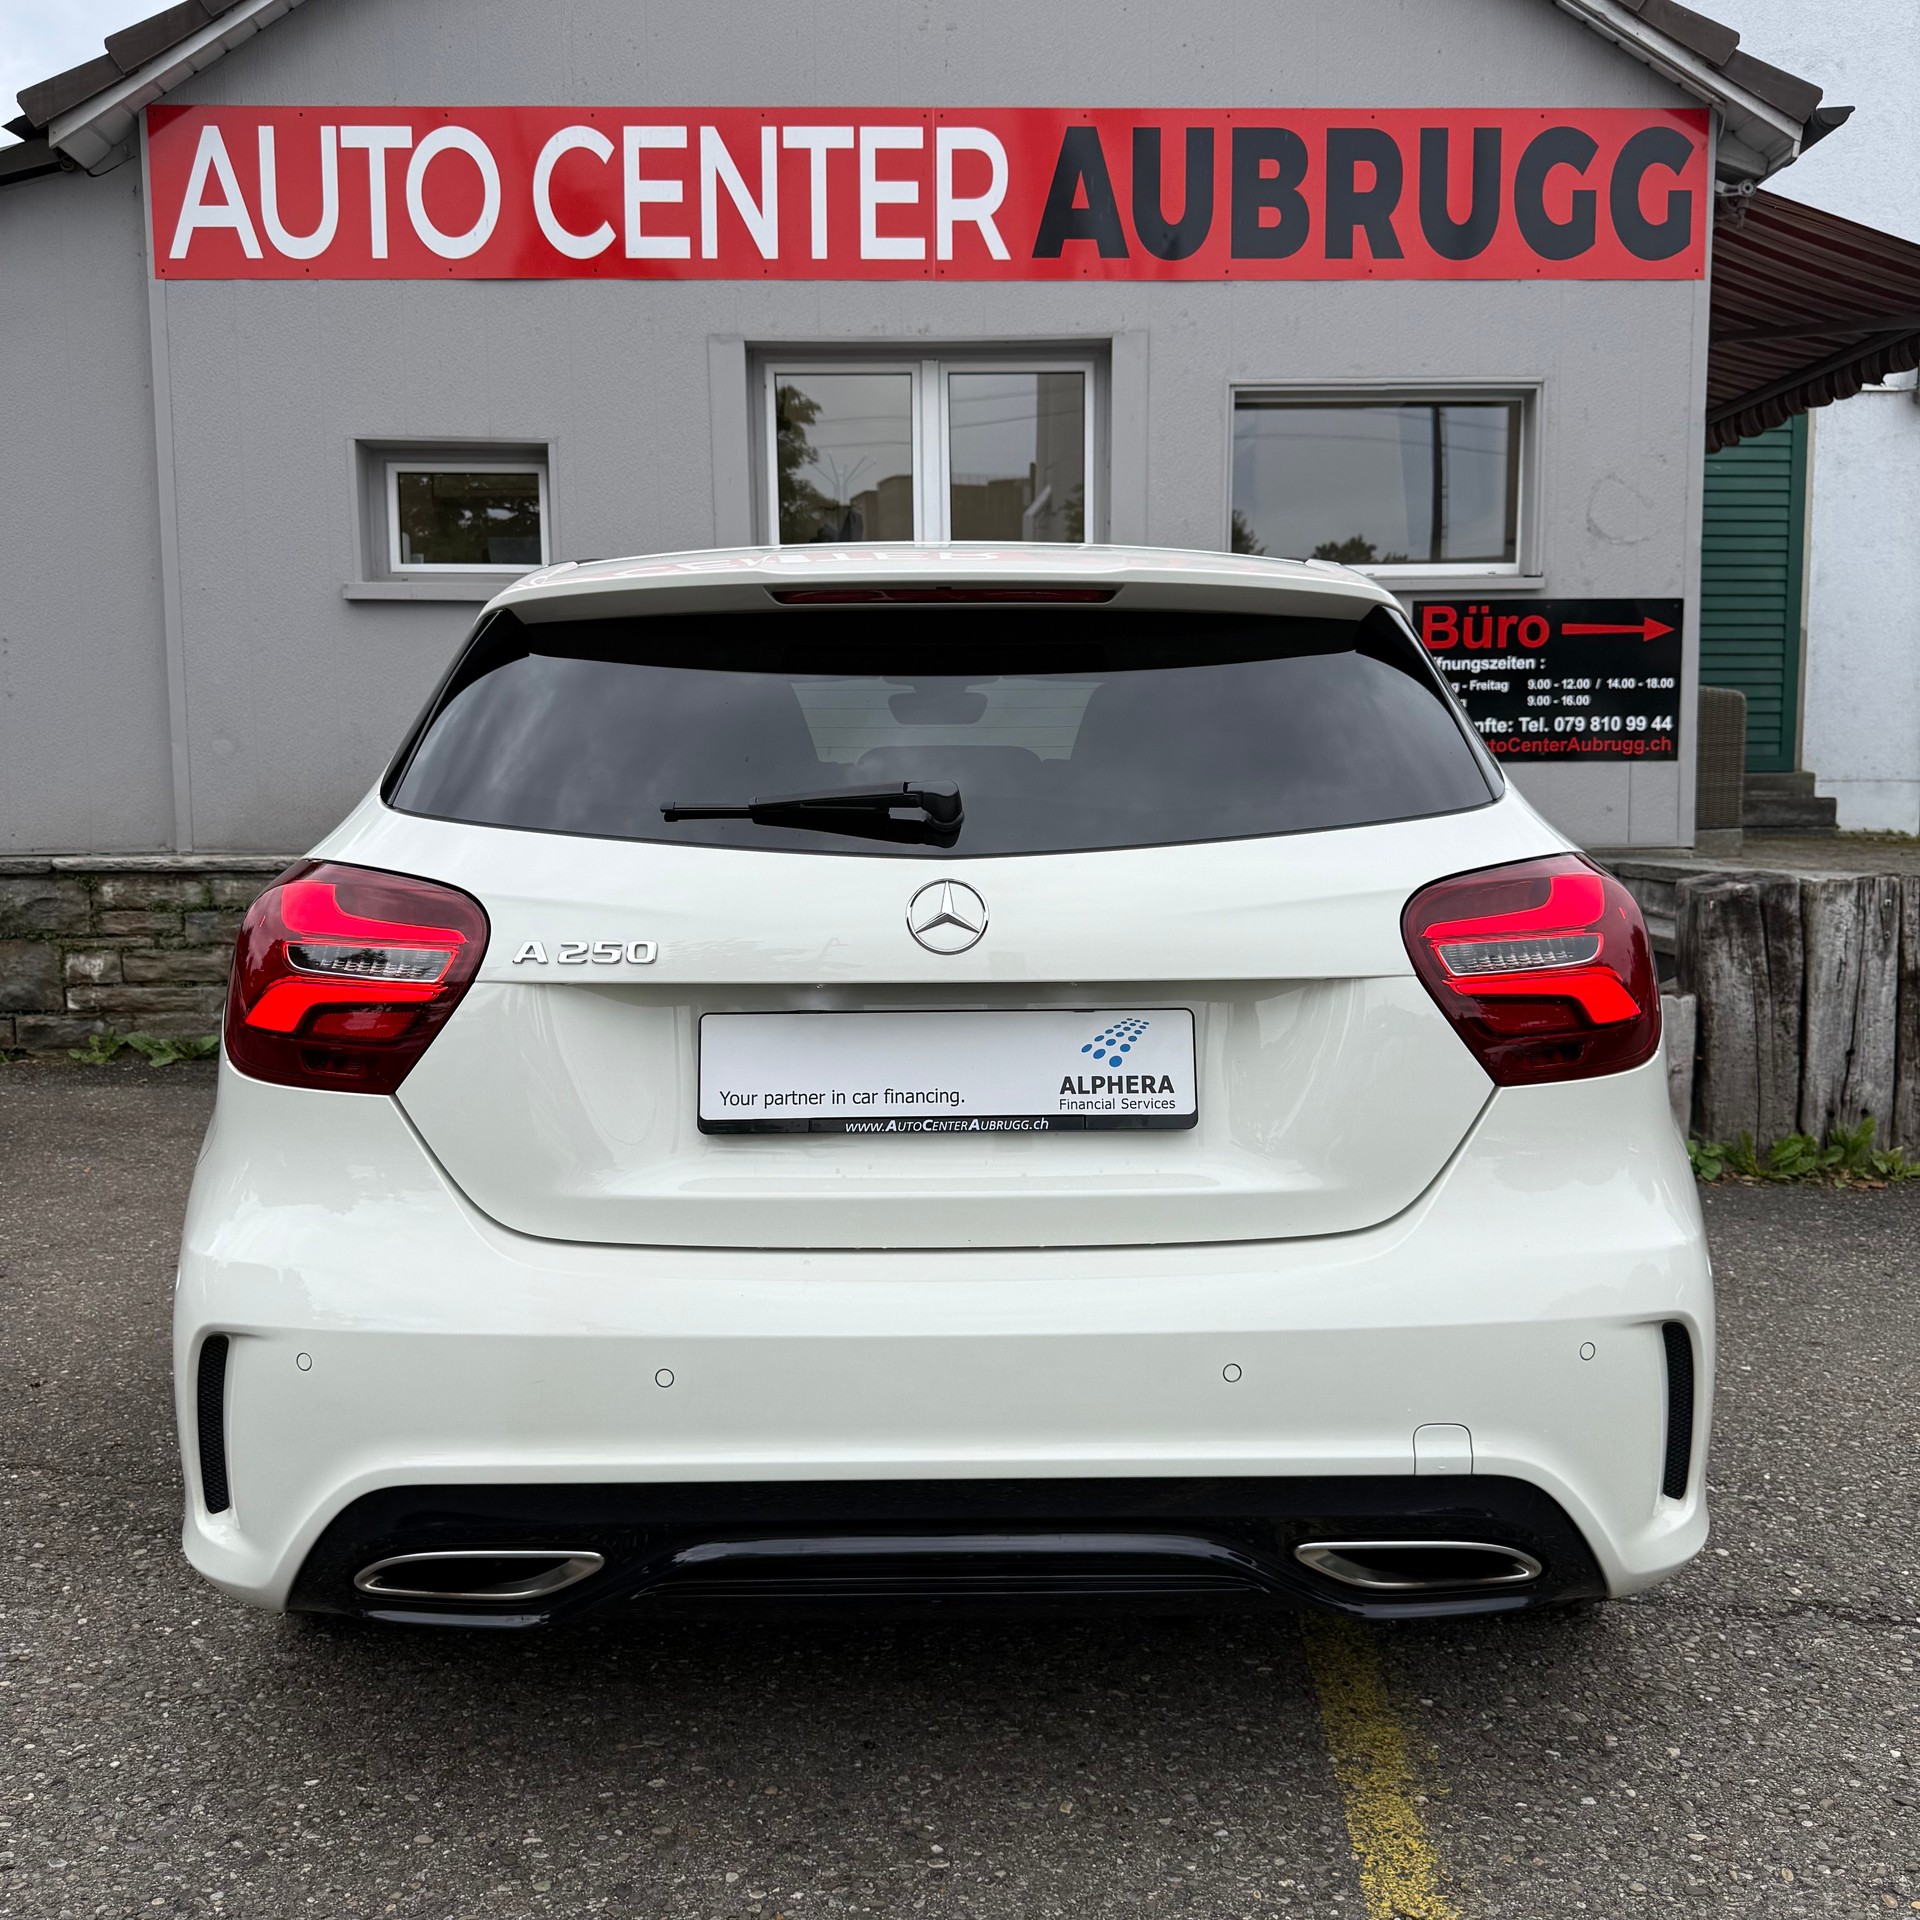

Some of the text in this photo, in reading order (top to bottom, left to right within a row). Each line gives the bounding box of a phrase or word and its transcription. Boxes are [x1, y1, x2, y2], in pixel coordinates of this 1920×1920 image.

[168, 124, 1695, 262] AUTO CENTER AUBRUGG
[1421, 604, 1550, 649] Büro
[1434, 655, 1537, 674] fnungszeiten
[1469, 680, 1511, 693] Freitag
[1527, 678, 1551, 690] 9.00
[1561, 678, 1592, 690] 12.00
[1606, 677, 1636, 689] 14.00
[1646, 677, 1675, 689] 18.00
[1527, 695, 1551, 707] 9.00
[1561, 695, 1591, 707] 16.00
[1474, 715, 1674, 733] nfte: Tel. 079 810 99 44
[1487, 736, 1672, 755] toCenterAubrugg.ch
[512, 941, 658, 965] A 250
[1059, 1075, 1175, 1095] ALPHERA
[720, 1088, 966, 1109] Your partner in car financing.
[1059, 1097, 1176, 1111] Financial Services
